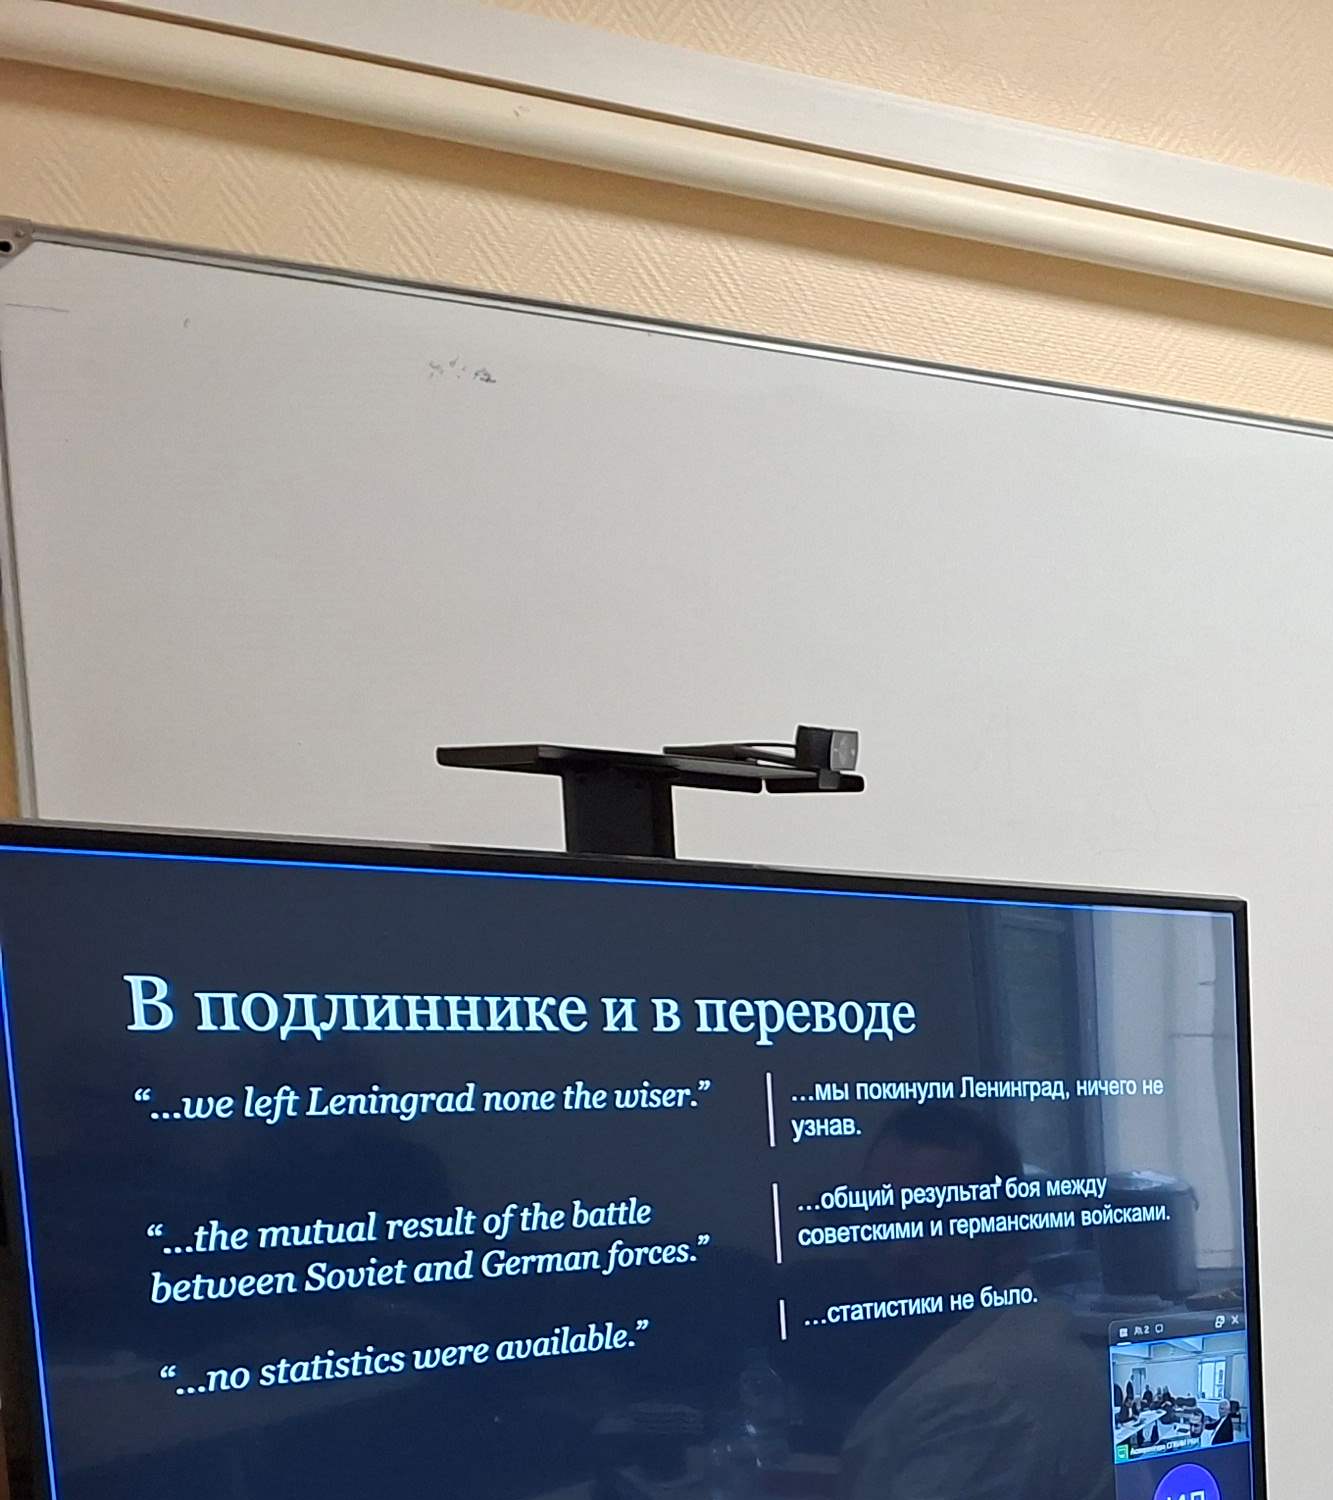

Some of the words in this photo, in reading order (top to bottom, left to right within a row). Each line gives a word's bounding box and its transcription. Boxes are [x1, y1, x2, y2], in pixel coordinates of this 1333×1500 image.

[123, 974, 175, 1031] В
[194, 991, 588, 1041] подлиннике
[601, 997, 639, 1033] и
[651, 997, 682, 1033] в
[695, 998, 917, 1047] переводе
[243, 1085, 300, 1125] left
[305, 1082, 476, 1122] Leningrad
[483, 1086, 556, 1113] none
[563, 1080, 608, 1111] the
[856, 1079, 954, 1105] покинули
[960, 1075, 1070, 1102] Ленинград,
[1076, 1078, 1137, 1097] ничего
[1142, 1078, 1164, 1096] не
[791, 1116, 862, 1143] узнав.
[900, 1181, 1000, 1210] результат
[1005, 1176, 1041, 1198] боя
[1046, 1175, 1107, 1198] между
[257, 1210, 377, 1249] mutual
[385, 1206, 476, 1240] result
[482, 1203, 518, 1241] of
[520, 1202, 565, 1232] the
[572, 1197, 652, 1229] battle
[798, 1219, 924, 1247] советскими
[930, 1219, 943, 1237] и
[949, 1210, 1075, 1243] германскими
[1081, 1203, 1171, 1227] войсками.
[150, 1271, 298, 1304] between
[304, 1257, 408, 1293] Soviet
[413, 1250, 474, 1284] and
[481, 1249, 602, 1279] German
[950, 1293, 975, 1312] не
[980, 1285, 1038, 1308] было.
[258, 1345, 406, 1388] statistics
[412, 1341, 490, 1371] were
